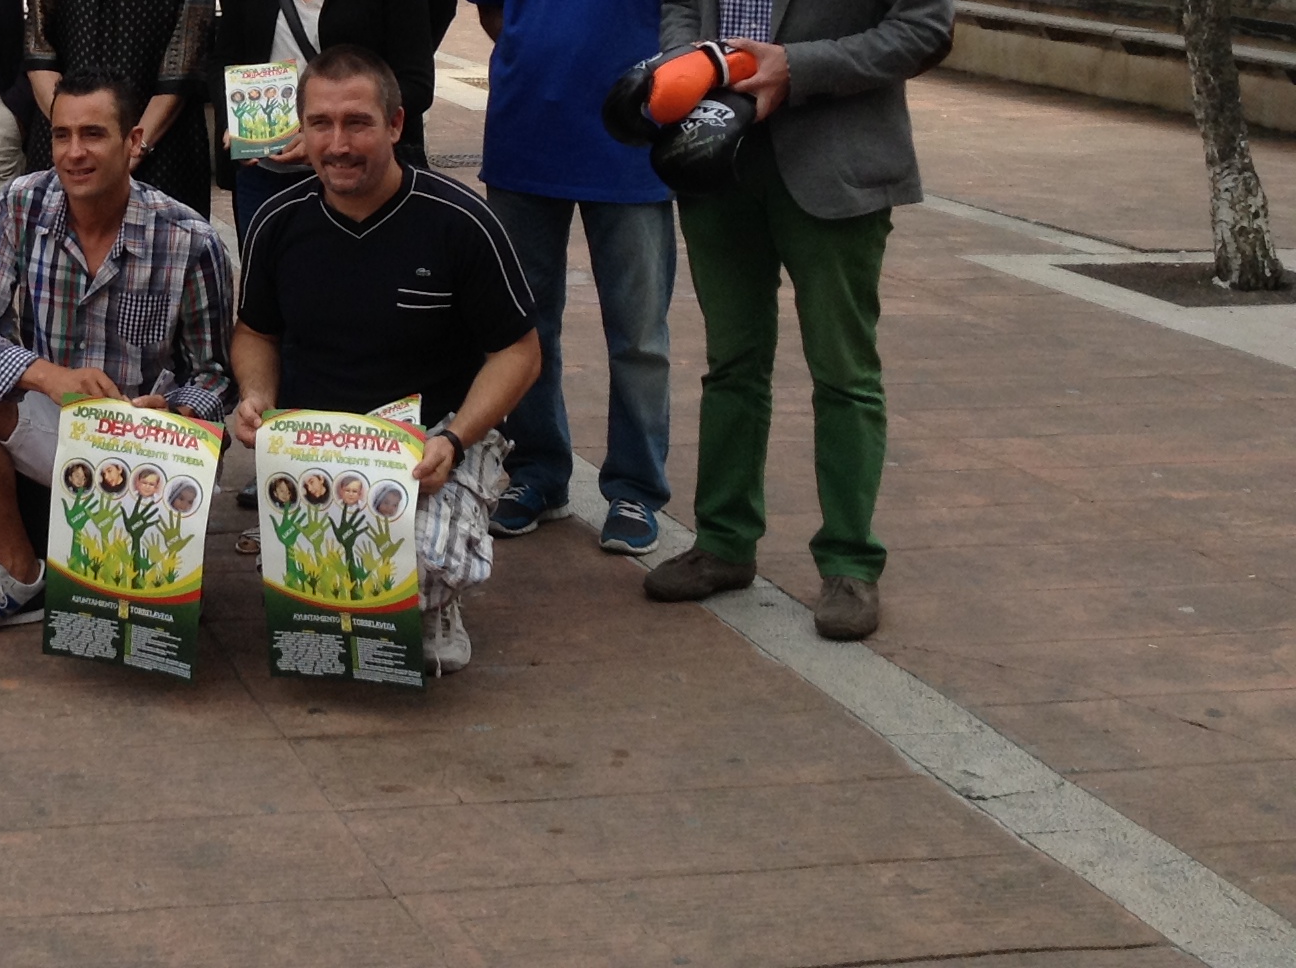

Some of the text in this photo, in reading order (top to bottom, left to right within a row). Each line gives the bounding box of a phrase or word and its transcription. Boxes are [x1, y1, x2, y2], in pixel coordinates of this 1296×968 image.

[72, 406, 210, 441] JORNADA SOLIDARIA
[95, 418, 200, 451] DEPORTIVA
[269, 420, 411, 444] JORNADA SOLIDARIA
[293, 430, 401, 454] DEPORTIVA
[292, 613, 397, 631] AYUNTAMIENTO TORRELAVEGA
